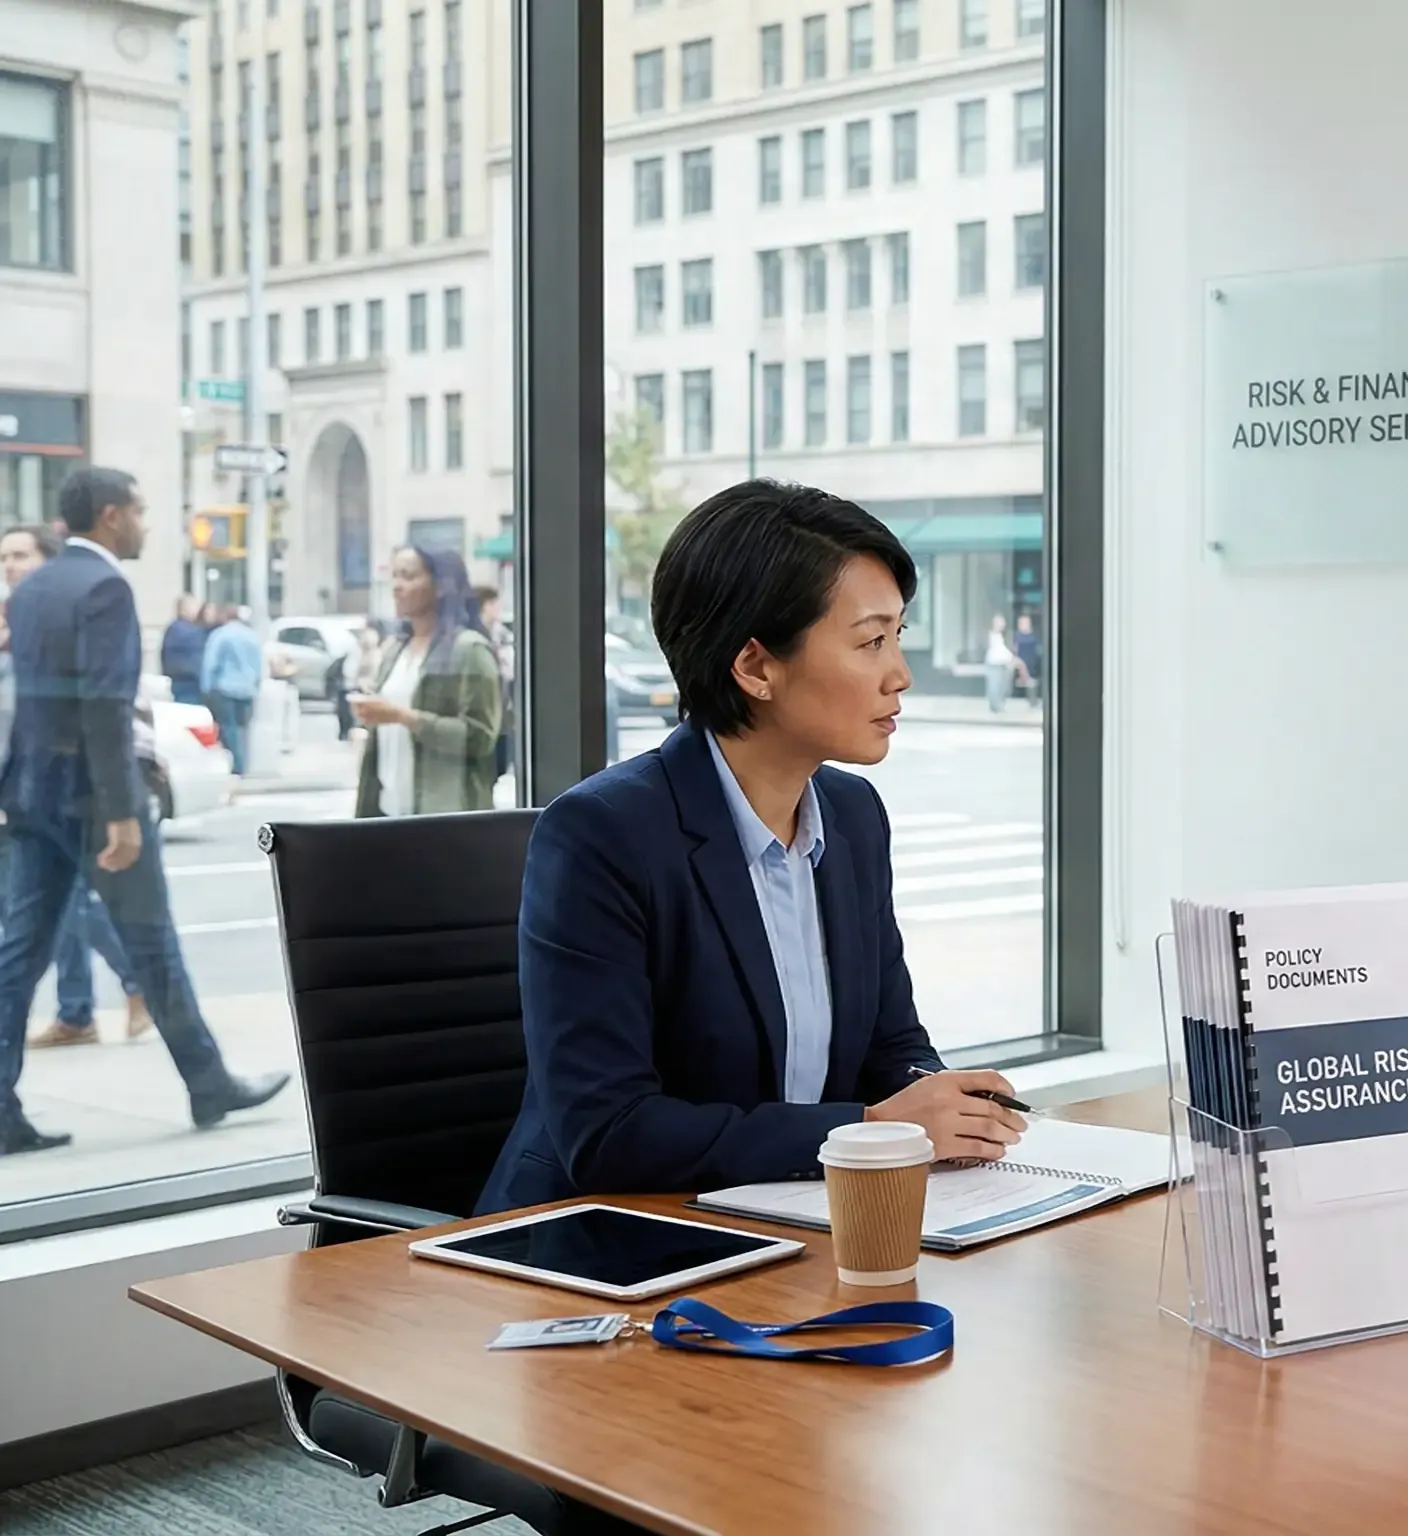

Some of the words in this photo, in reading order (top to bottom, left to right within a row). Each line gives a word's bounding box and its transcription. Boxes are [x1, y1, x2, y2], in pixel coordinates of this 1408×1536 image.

[1249, 380, 1305, 407] RISK
[1313, 378, 1329, 404] &
[1232, 417, 1361, 448] ADVISORY
[1266, 948, 1321, 966] POLICY
[1268, 967, 1367, 989] DOCUMENTS
[1277, 1053, 1367, 1084] GLOBAL
